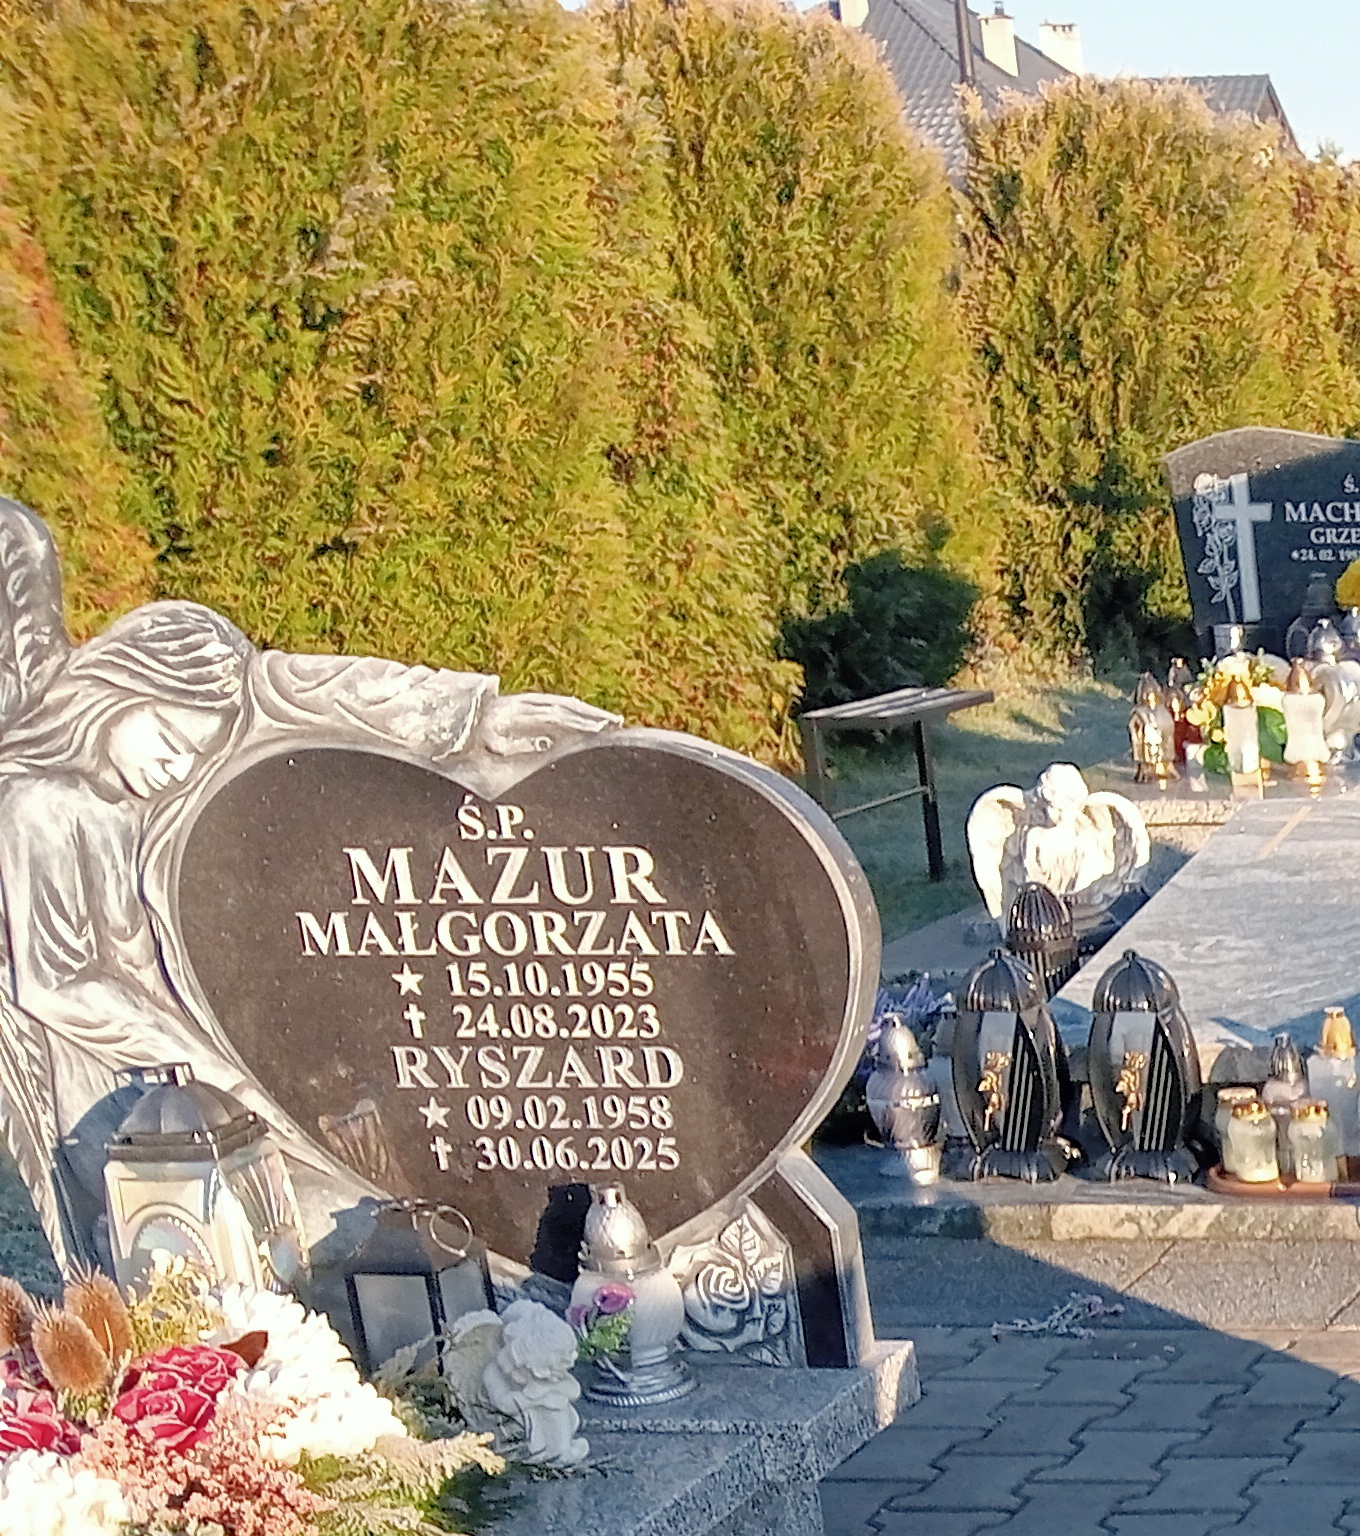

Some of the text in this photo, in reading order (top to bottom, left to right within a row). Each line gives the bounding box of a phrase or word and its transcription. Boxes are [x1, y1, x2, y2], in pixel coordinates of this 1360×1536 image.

[457, 795, 535, 840] Ś.P.
[343, 845, 667, 906] MAZUR
[295, 911, 736, 957] MAŁGORZATA
[445, 961, 655, 998] 15.10.1955
[452, 1003, 661, 1039] 24.08.2023
[390, 1045, 685, 1089] RYSZARD
[466, 1095, 675, 1130] 09.02.1958
[475, 1135, 681, 1171] 30.06.2025
